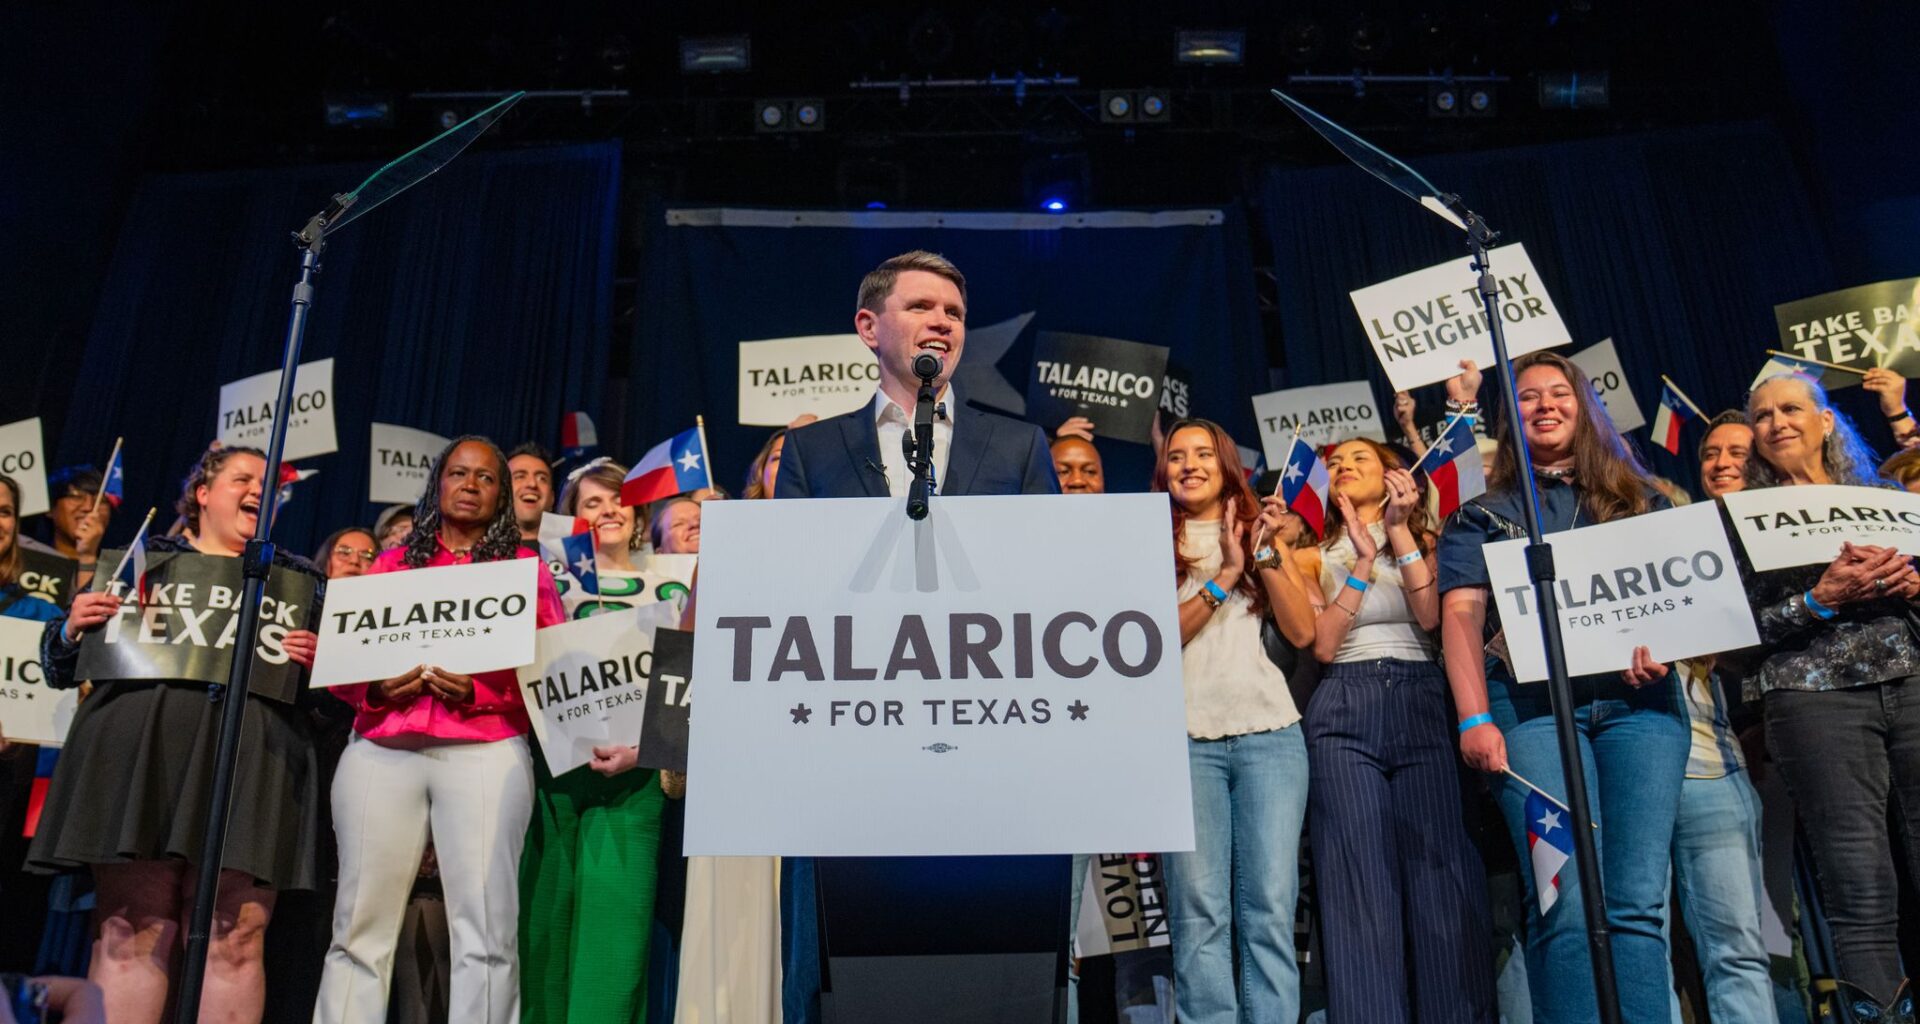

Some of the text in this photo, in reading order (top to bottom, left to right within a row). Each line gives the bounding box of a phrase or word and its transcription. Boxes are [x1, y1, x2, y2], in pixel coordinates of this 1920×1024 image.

[1371, 294, 1459, 340] LOVE
[1382, 296, 1547, 362] NEIGHOR
[1789, 303, 1912, 342] TAKE BA
[748, 363, 880, 387] TALARICO
[1037, 361, 1154, 399] TALARICO
[782, 385, 850, 397] FOR TEXAS
[1058, 388, 1118, 407] FOR TEXAS
[223, 390, 326, 430] TALAICO
[1264, 404, 1373, 433] TALARICO
[378, 449, 436, 469] TALA
[406, 470, 424, 479] FOR
[1808, 524, 1913, 536] FOR TEXAS
[1505, 550, 1724, 616] TLARICO
[332, 594, 527, 634] TALARICO
[1569, 599, 1676, 629] FOR TEXAS
[378, 627, 476, 644] FOR TEXAS
[716, 610, 1163, 682] TALARICO
[567, 689, 643, 721] FOR TEXAS
[830, 699, 1051, 726] FOR TEXAS
